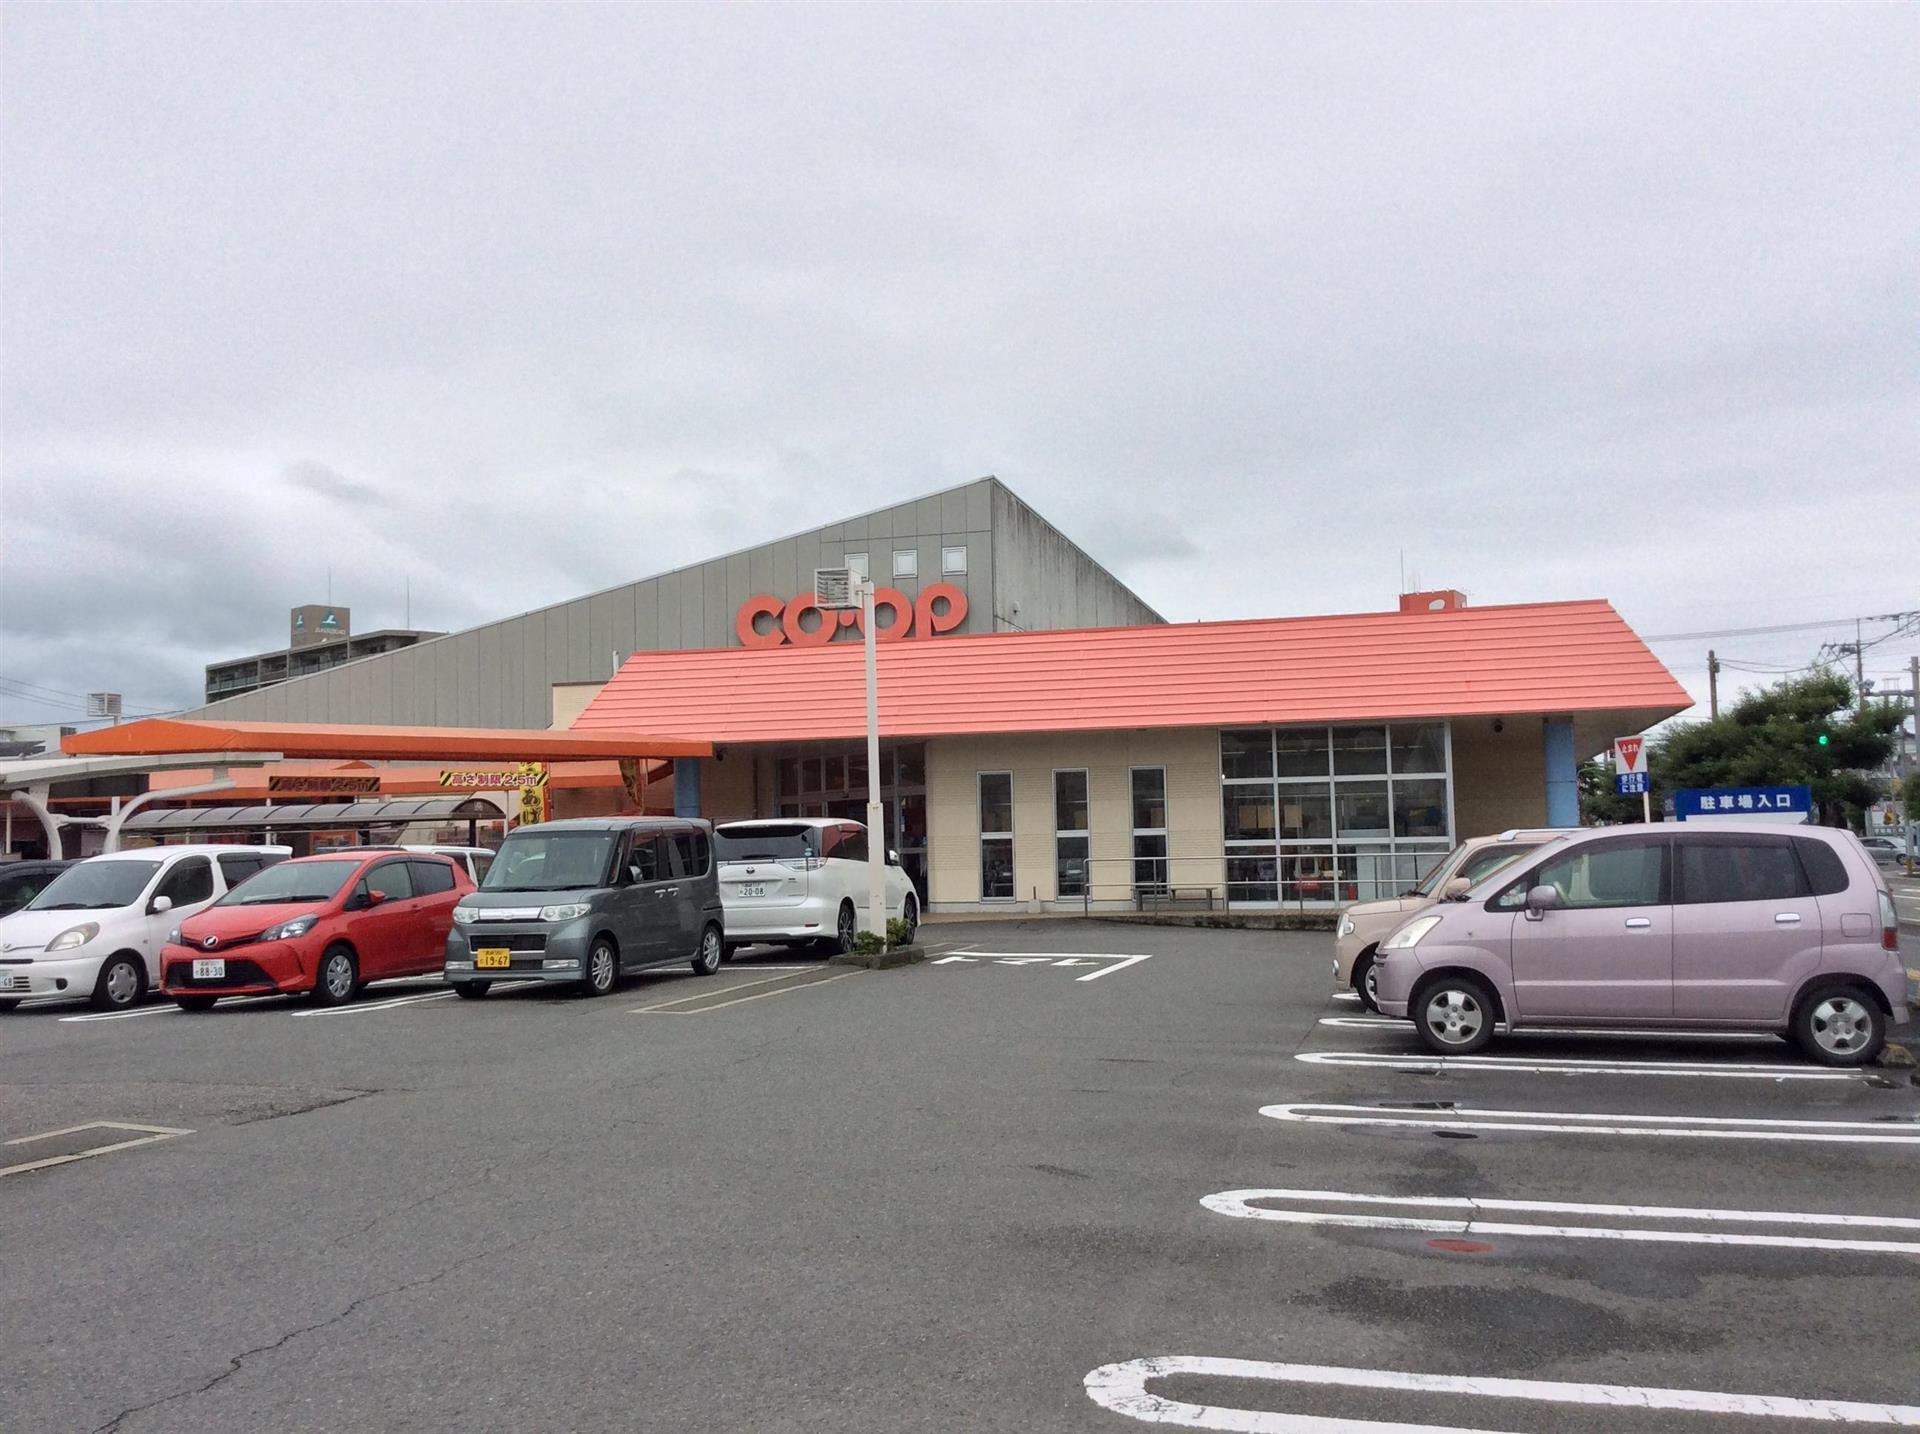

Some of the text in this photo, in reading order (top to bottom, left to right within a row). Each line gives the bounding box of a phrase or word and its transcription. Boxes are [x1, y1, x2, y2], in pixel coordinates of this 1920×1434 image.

[1700, 794, 1791, 809] 駐車場入口
